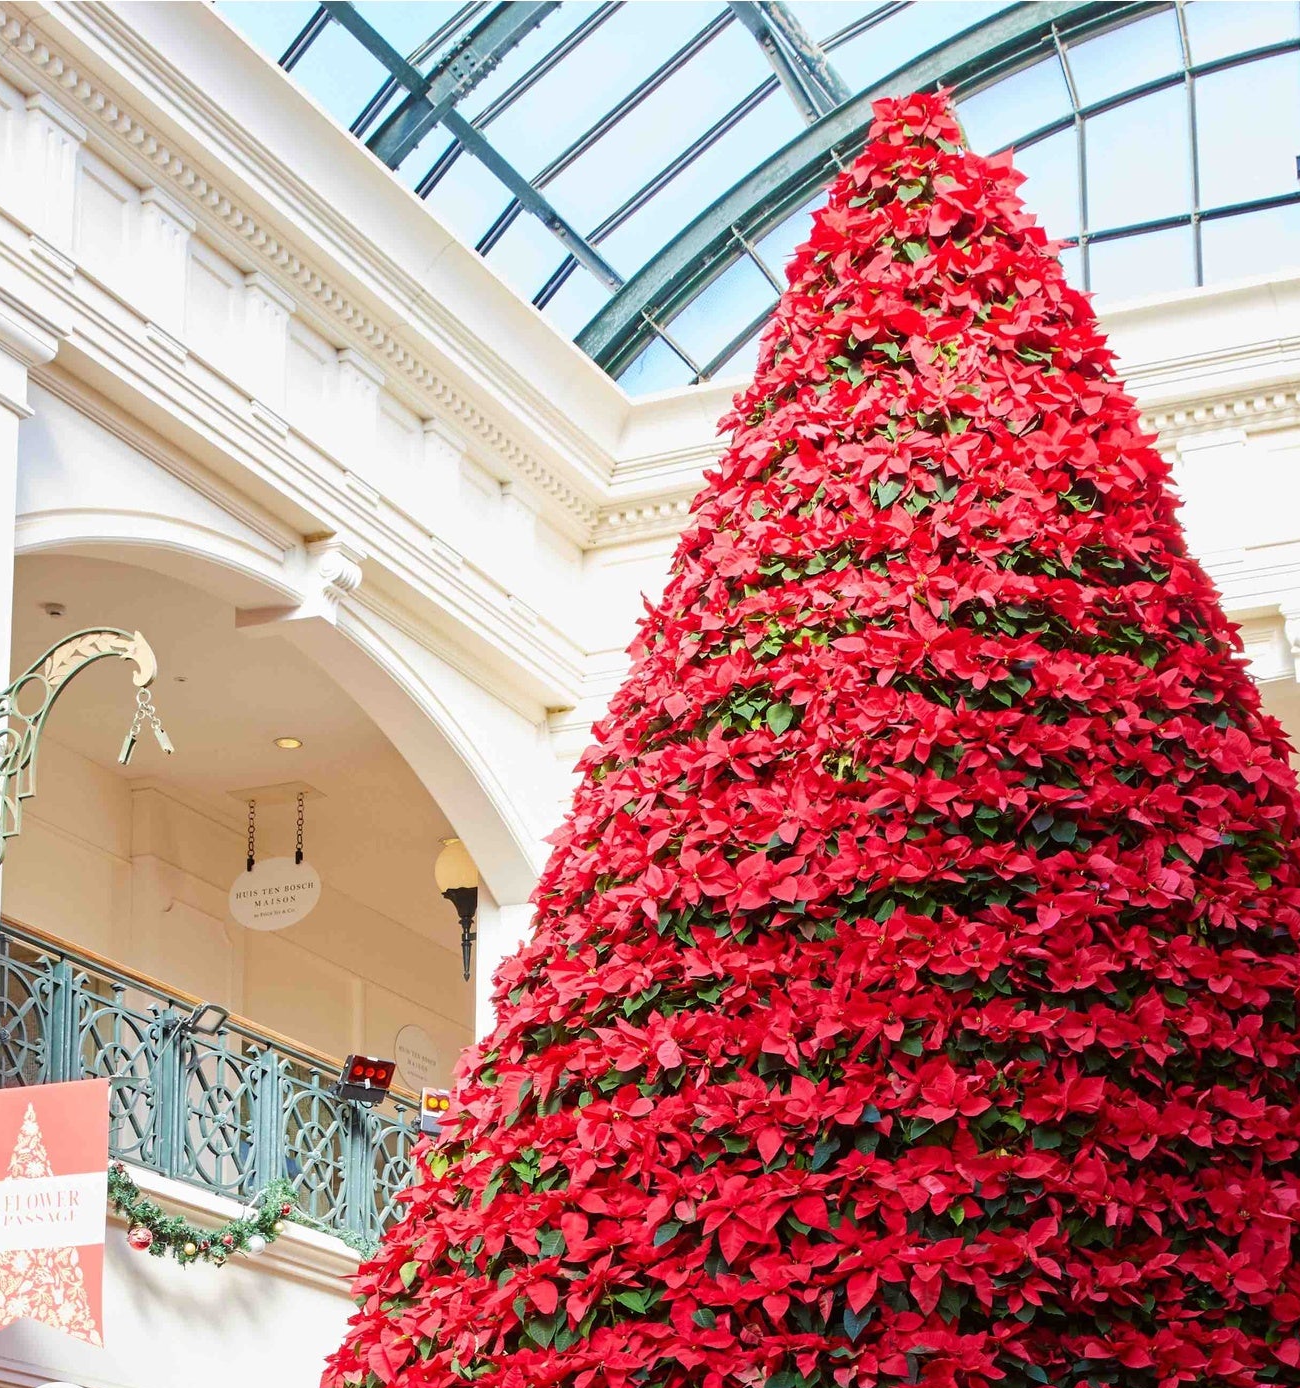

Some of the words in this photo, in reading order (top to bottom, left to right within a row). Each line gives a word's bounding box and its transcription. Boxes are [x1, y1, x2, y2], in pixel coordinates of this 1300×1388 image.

[236, 889, 258, 900] HUIS
[262, 886, 280, 895] TEN
[284, 881, 314, 893] BOSCH
[254, 895, 296, 907] MAISON
[4, 1190, 79, 1212] FLOWER
